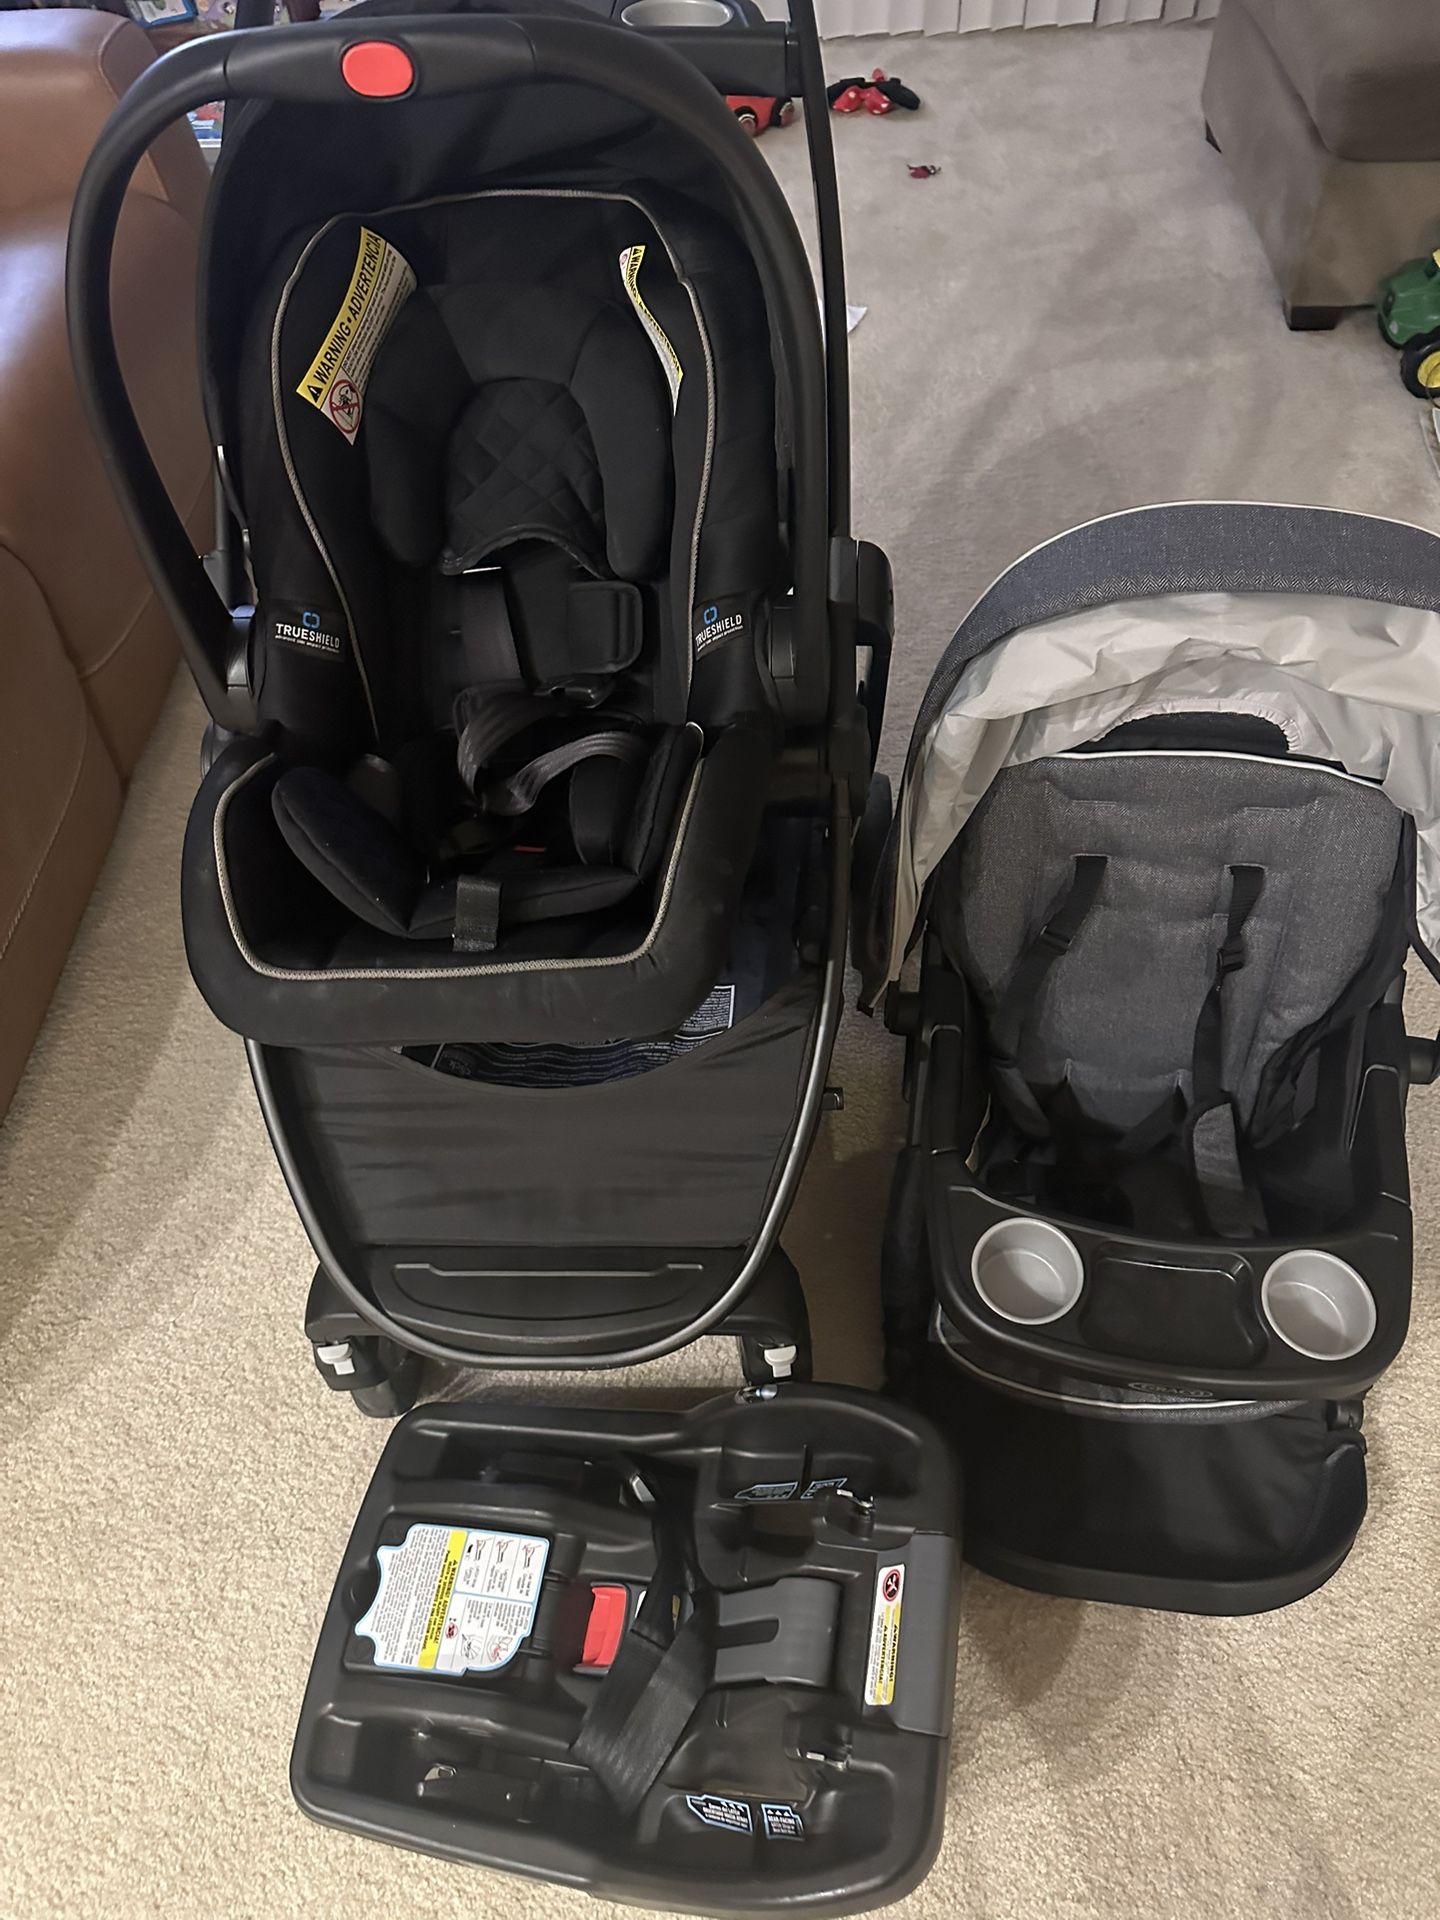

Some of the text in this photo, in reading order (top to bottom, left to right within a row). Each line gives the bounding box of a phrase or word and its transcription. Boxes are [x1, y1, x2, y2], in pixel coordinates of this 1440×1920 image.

[627, 256, 641, 297] WARNING
[313, 321, 351, 384] WARNING
[351, 233, 382, 321] ADVERTENCIA
[276, 623, 340, 648] TRUESHIELD
[695, 614, 742, 646] TRUESHIELD
[889, 1633, 897, 1682] WARNING!
